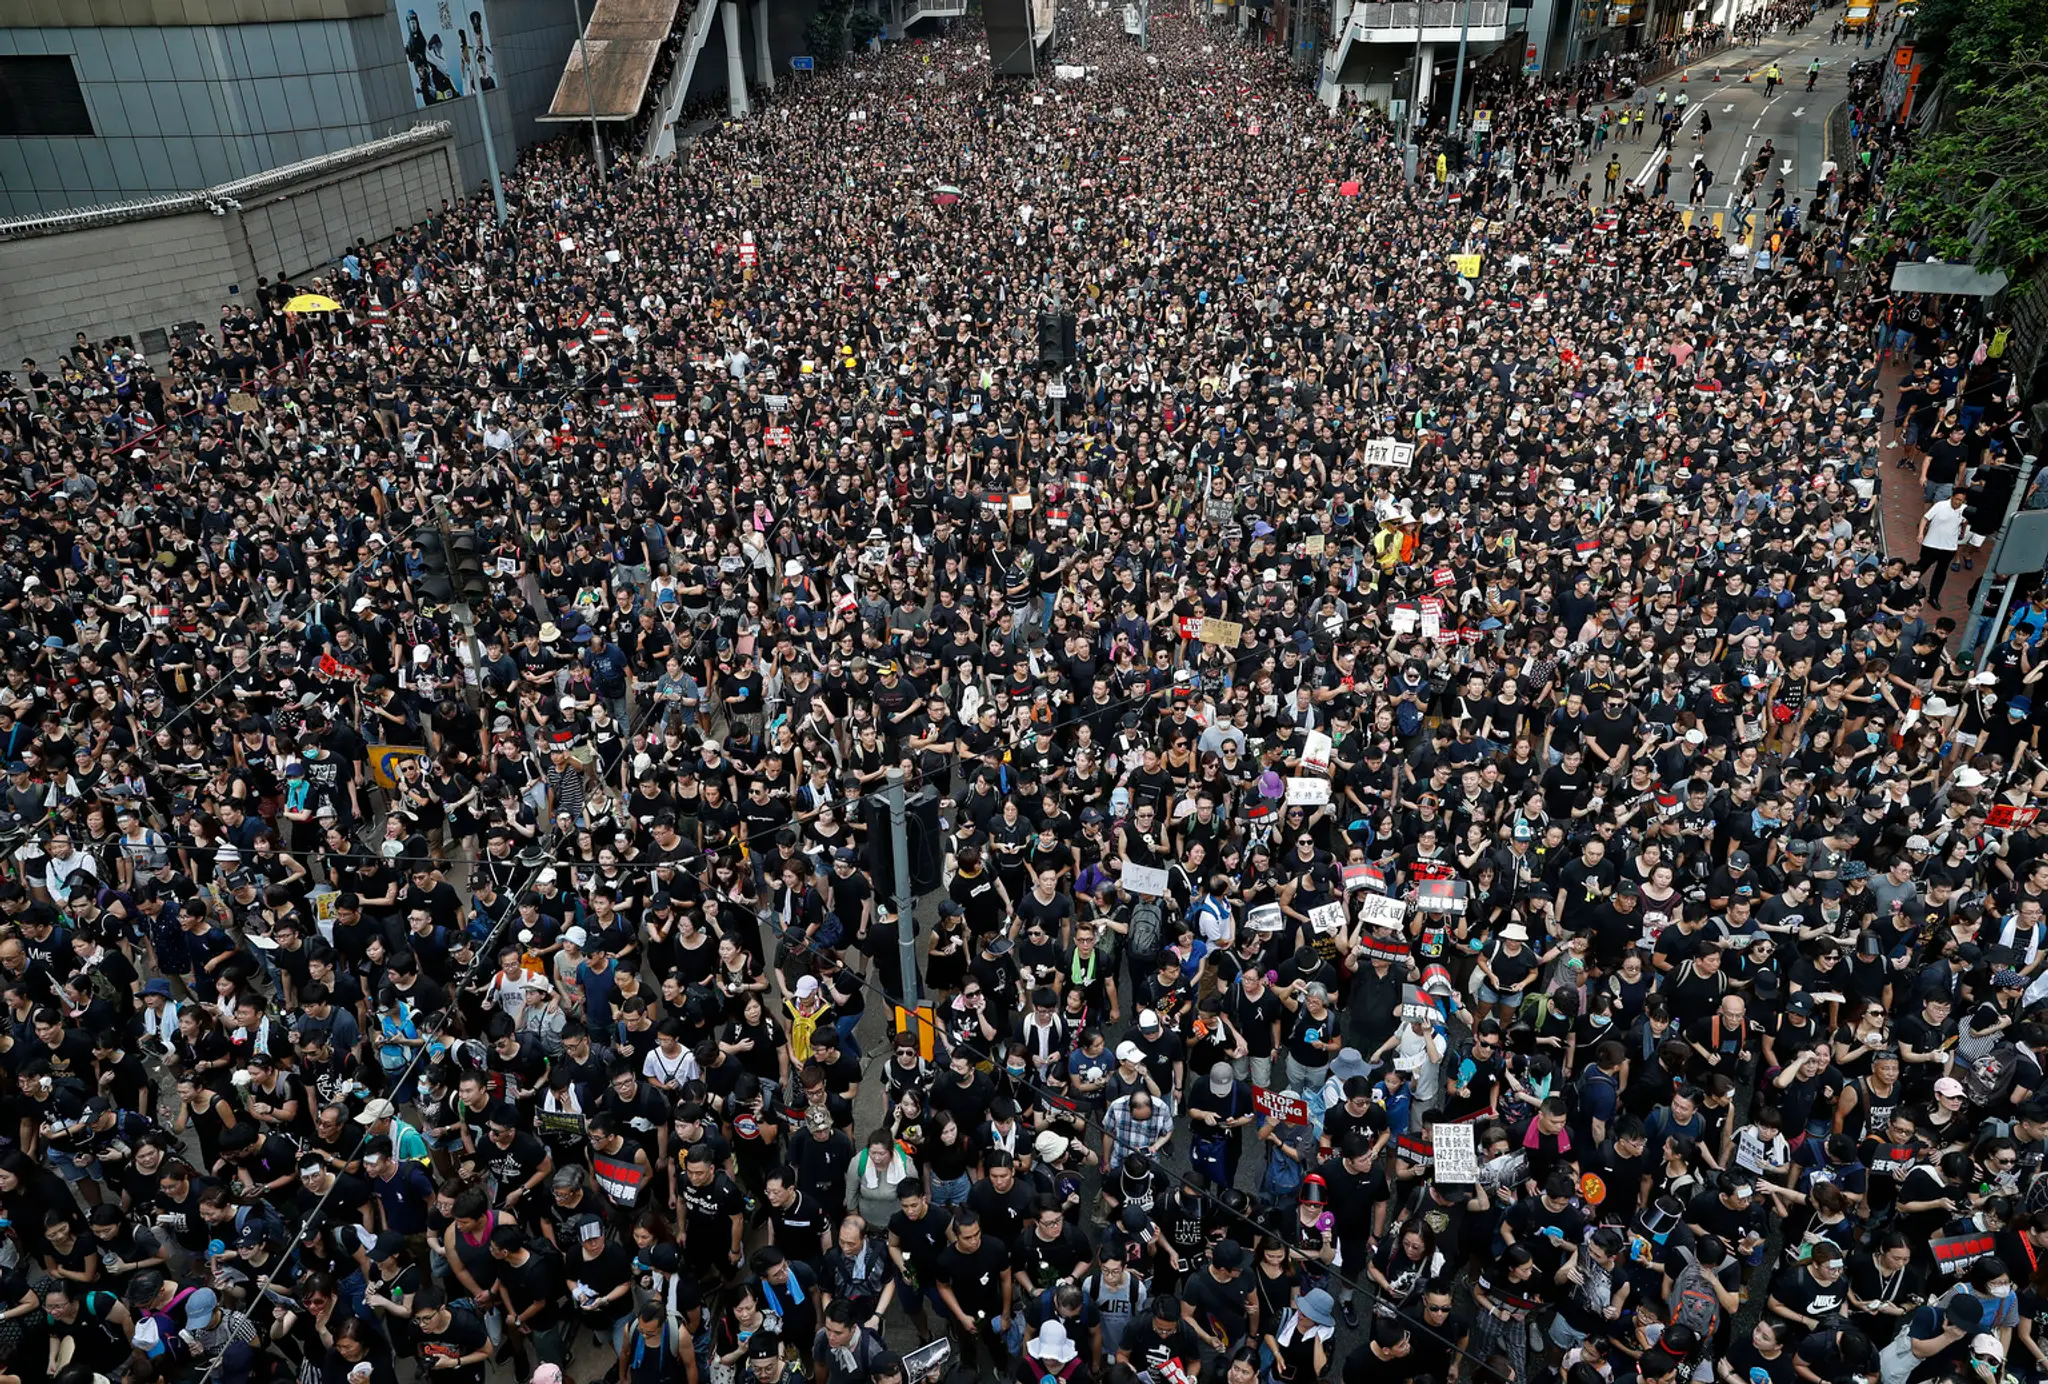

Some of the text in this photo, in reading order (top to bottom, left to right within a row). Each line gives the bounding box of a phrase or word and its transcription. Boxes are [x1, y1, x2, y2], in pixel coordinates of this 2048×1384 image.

[1368, 444, 1412, 466] 撤回
[1187, 618, 1203, 626] STO
[1366, 895, 1405, 921] 撤回
[1312, 904, 1343, 928] 道歉
[504, 992, 523, 1001] USA
[1263, 1091, 1295, 1106] STOP
[1256, 1096, 1302, 1117] KILLING
[1270, 1110, 1287, 1120] US
[1871, 1157, 1916, 1172] 沒有
[1175, 1219, 1201, 1233] LIVE
[1940, 1250, 1996, 1275] 撤回
[1814, 1294, 1837, 1307] NIKE
